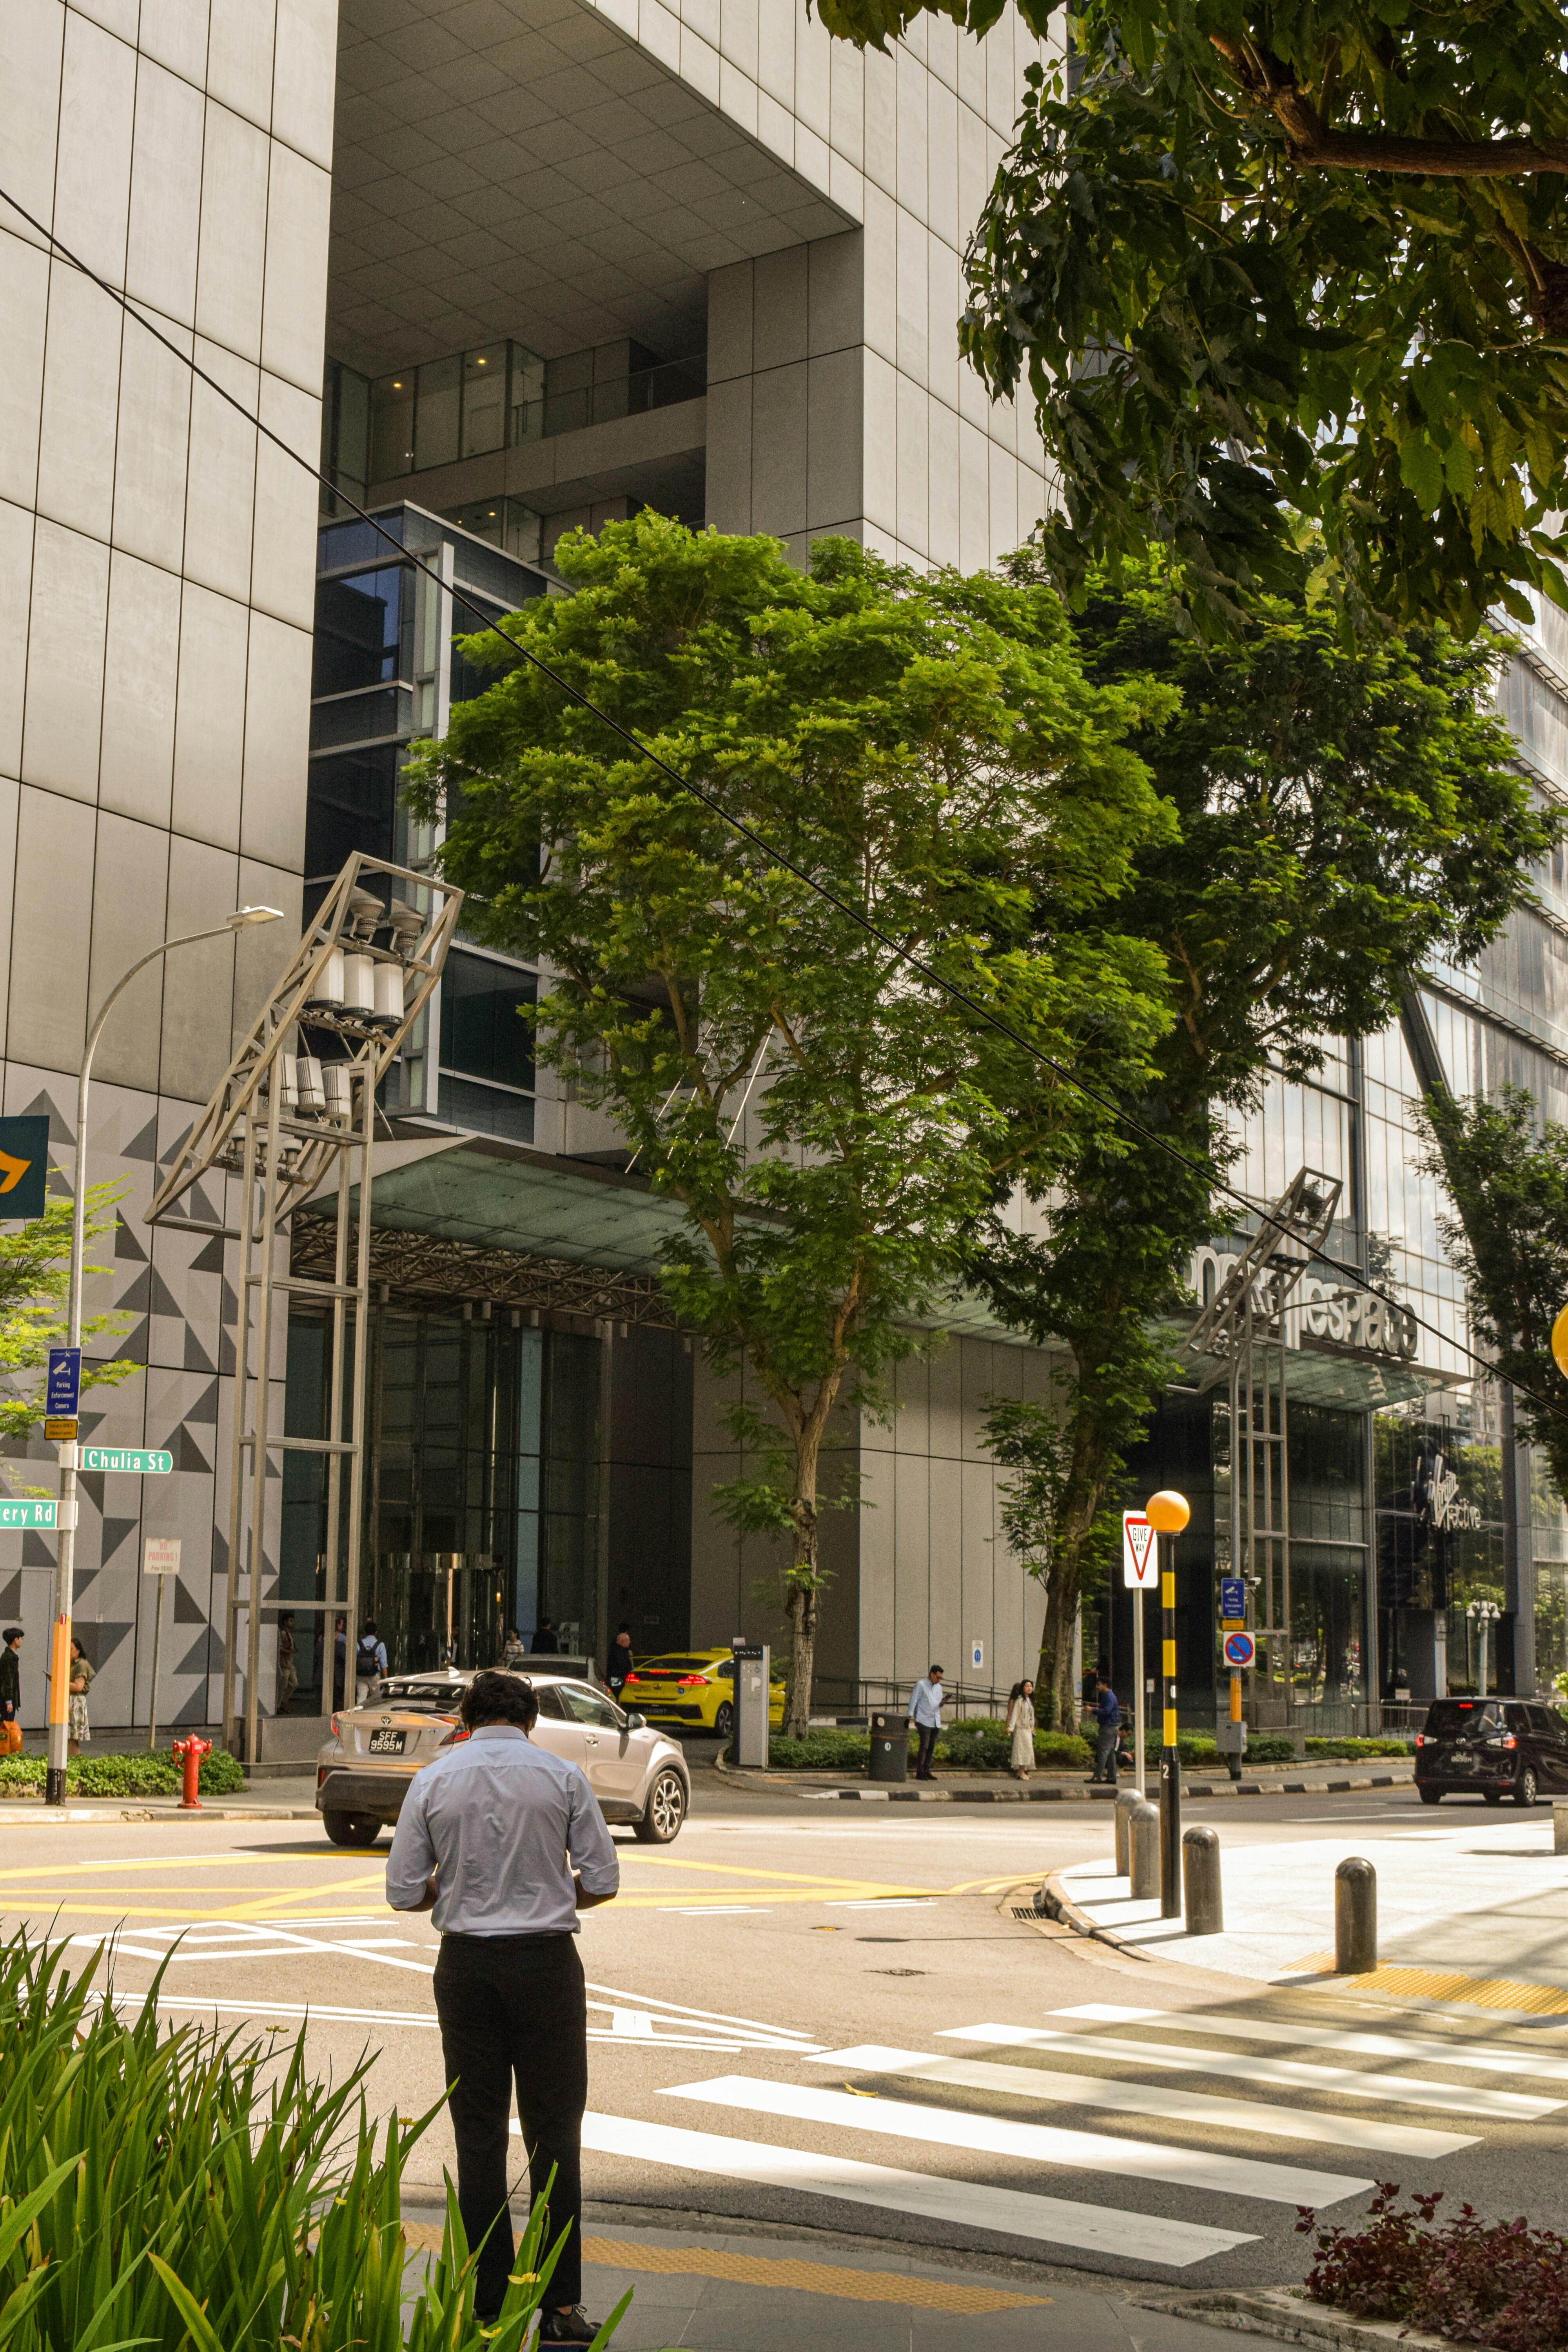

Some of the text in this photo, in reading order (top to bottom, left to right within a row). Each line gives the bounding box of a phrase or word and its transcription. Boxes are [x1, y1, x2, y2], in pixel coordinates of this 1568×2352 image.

[89, 1450, 164, 1470] Chulia St
[0, 1504, 52, 1525] ery Rd
[1133, 1528, 1147, 1541] GIVE
[160, 1542, 168, 1550] NO
[1135, 1543, 1145, 1552] WAY
[379, 1731, 398, 1741] SFF
[370, 1740, 403, 1750] 9595M
[1163, 1764, 1169, 1779] 2
